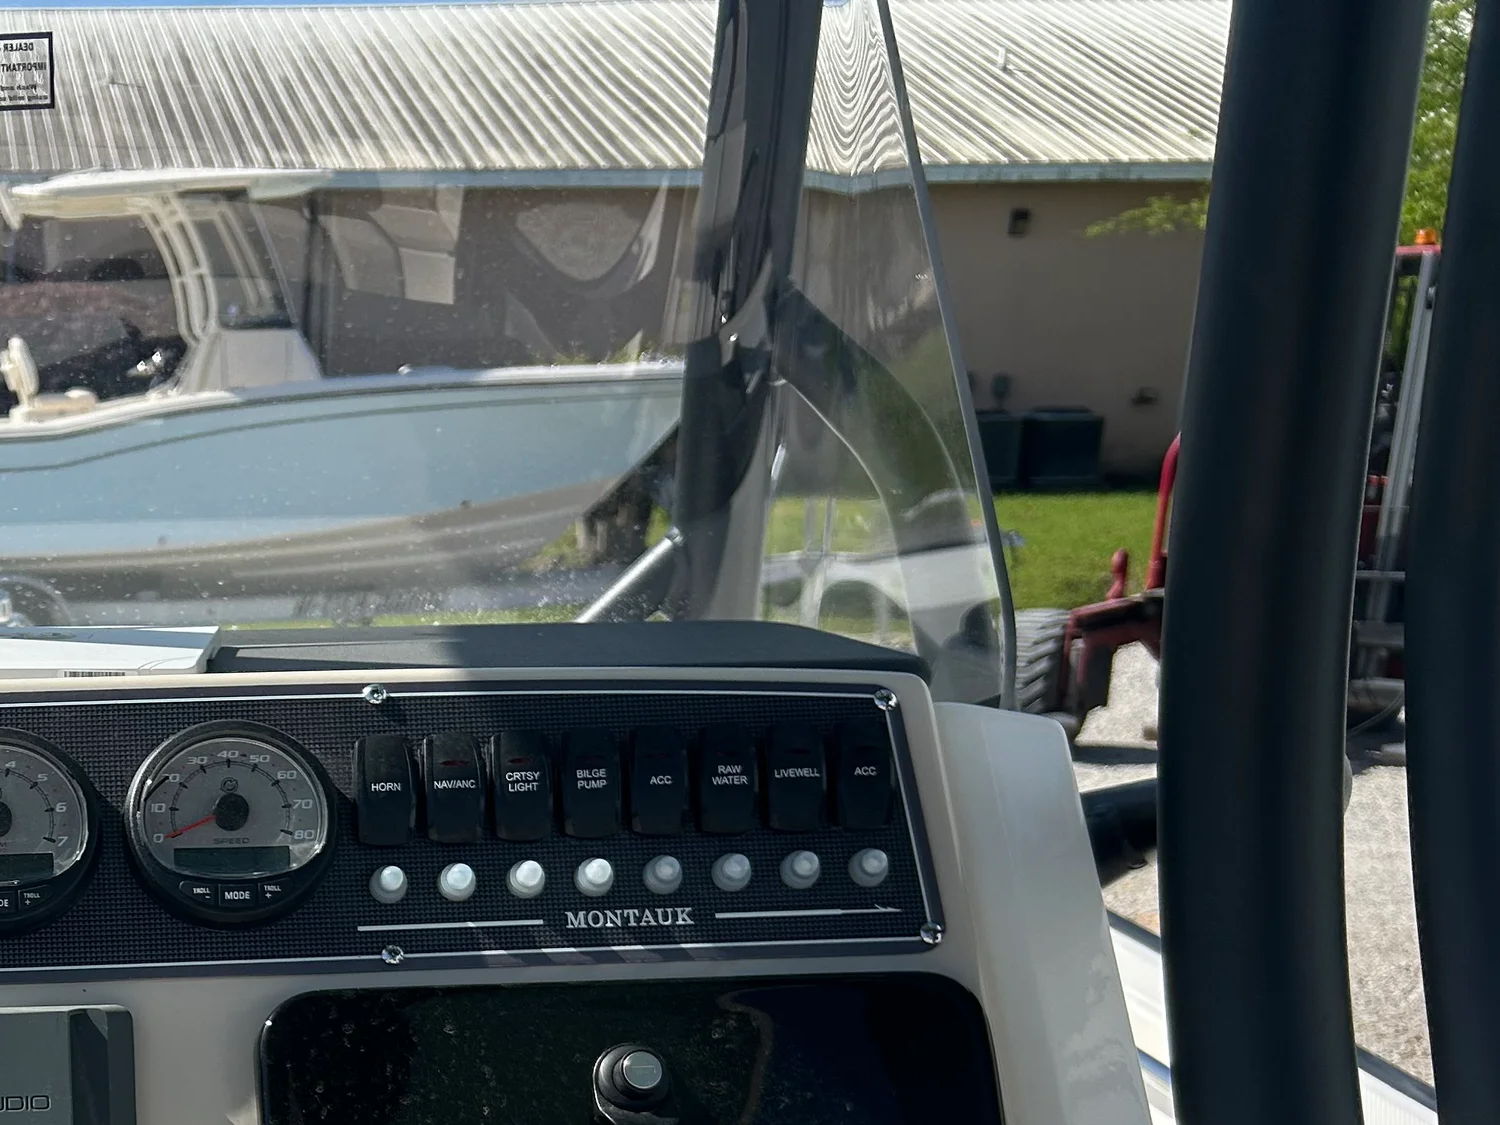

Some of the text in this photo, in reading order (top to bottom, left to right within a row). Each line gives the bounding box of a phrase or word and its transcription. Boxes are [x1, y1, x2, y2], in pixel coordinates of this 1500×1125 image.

[216, 750, 239, 758] 40
[249, 754, 270, 763] 50
[5, 760, 16, 768] 4
[187, 756, 208, 765] 30
[576, 768, 607, 779] BILGE
[717, 764, 743, 774] RAW
[774, 768, 820, 778] LIVEWELL
[854, 766, 878, 776] ACC
[37, 774, 48, 782] 5
[277, 770, 298, 779] 60
[505, 771, 540, 782] CRTSY
[433, 779, 476, 790] NAV/ANC
[577, 779, 608, 790] PUMP
[650, 775, 672, 785] ACC
[711, 775, 749, 785] WATER
[371, 782, 401, 792] HORN
[508, 782, 539, 792] LIGHT
[55, 803, 67, 812] 6
[150, 803, 166, 813] 10
[292, 799, 313, 809] 70
[153, 834, 164, 843] 0
[293, 830, 315, 840] 80
[57, 837, 68, 847] 7
[224, 891, 251, 900] MODE
[565, 907, 695, 928] MONTAUK
